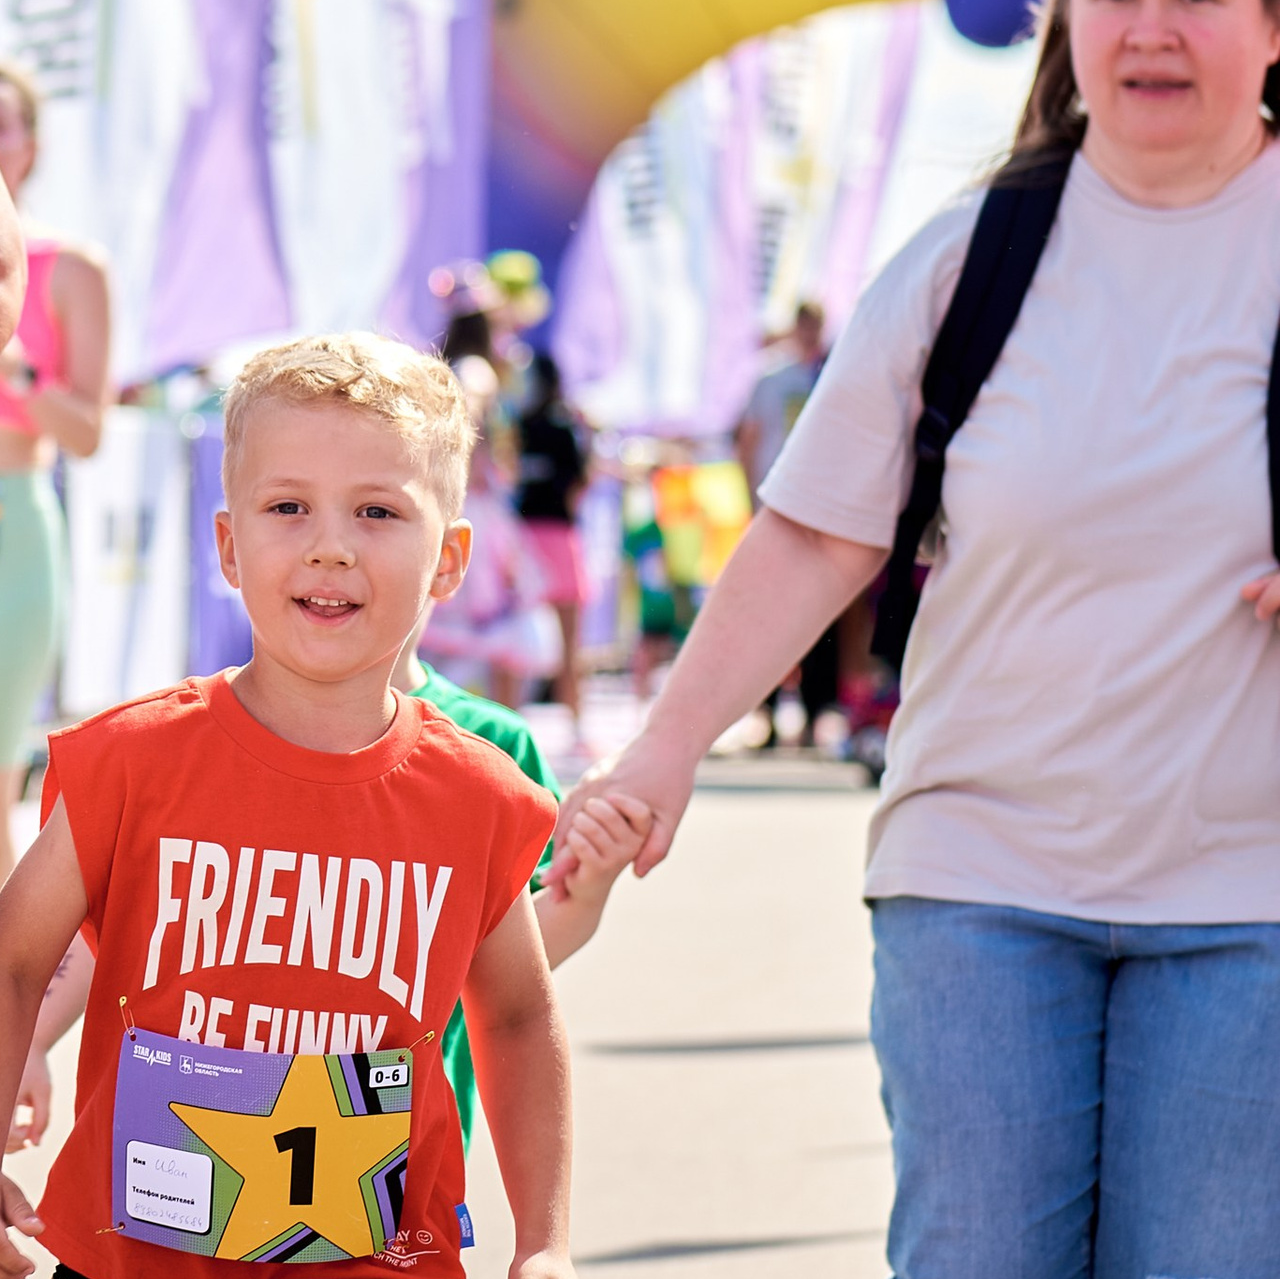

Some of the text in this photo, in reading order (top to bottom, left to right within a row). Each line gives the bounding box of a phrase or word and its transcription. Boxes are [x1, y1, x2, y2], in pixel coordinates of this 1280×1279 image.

[142, 837, 454, 1023] FRIENDLY
[133, 1044, 172, 1063] STAR KIDS
[375, 1069, 401, 1084] 0-6
[133, 1157, 146, 1166] Имя
[273, 1126, 317, 1206] 1
[132, 1186, 195, 1205] Телефон родителей
[385, 1255, 400, 1266] THE
